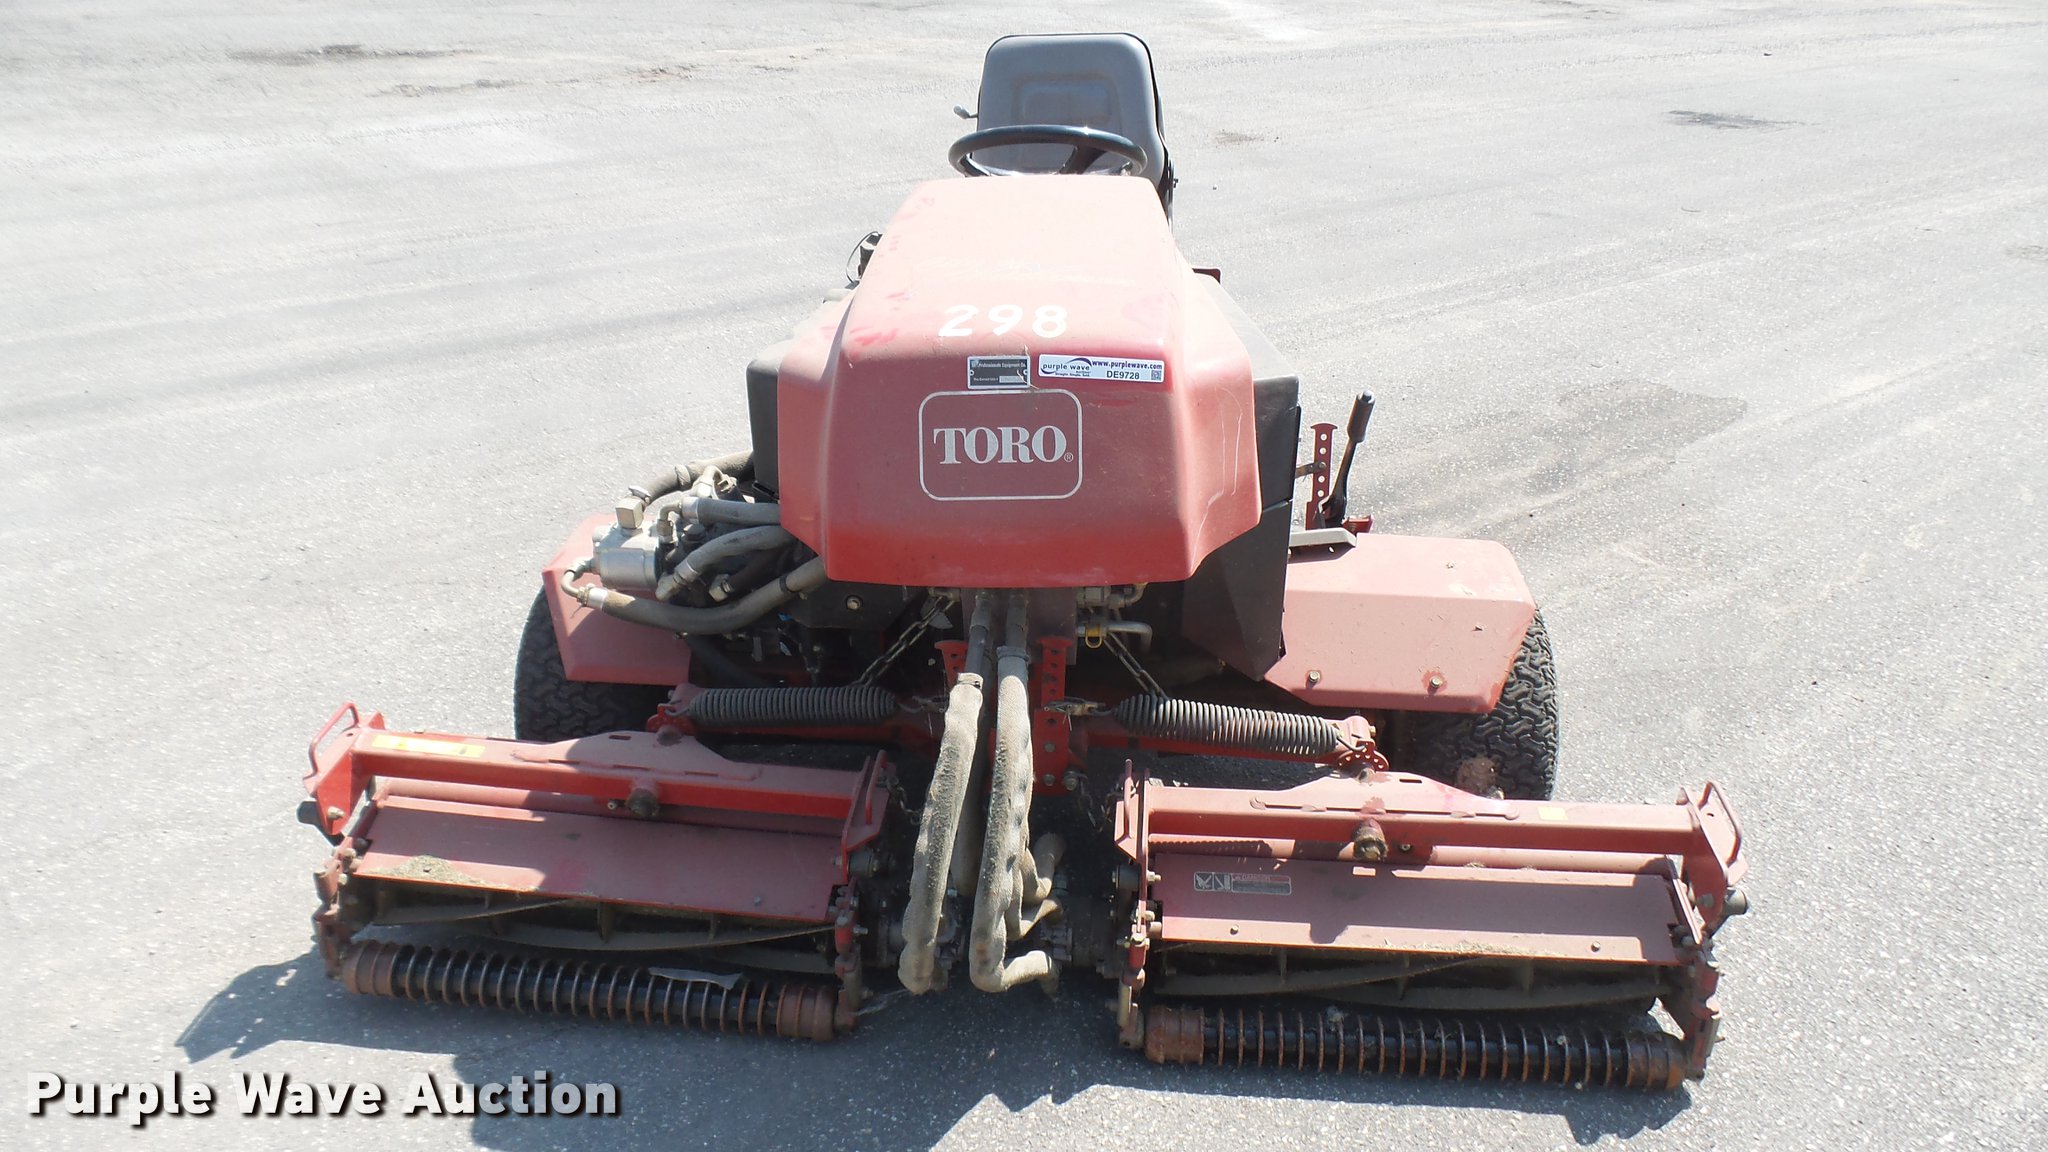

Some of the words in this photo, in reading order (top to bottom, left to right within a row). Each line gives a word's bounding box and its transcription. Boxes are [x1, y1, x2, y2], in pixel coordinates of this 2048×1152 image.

[937, 303, 1068, 339] 298
[1042, 363, 1067, 371] purple
[1091, 360, 1163, 370] www.purplewave.com
[1106, 370, 1140, 380] DE9728
[933, 425, 1067, 465] TORO
